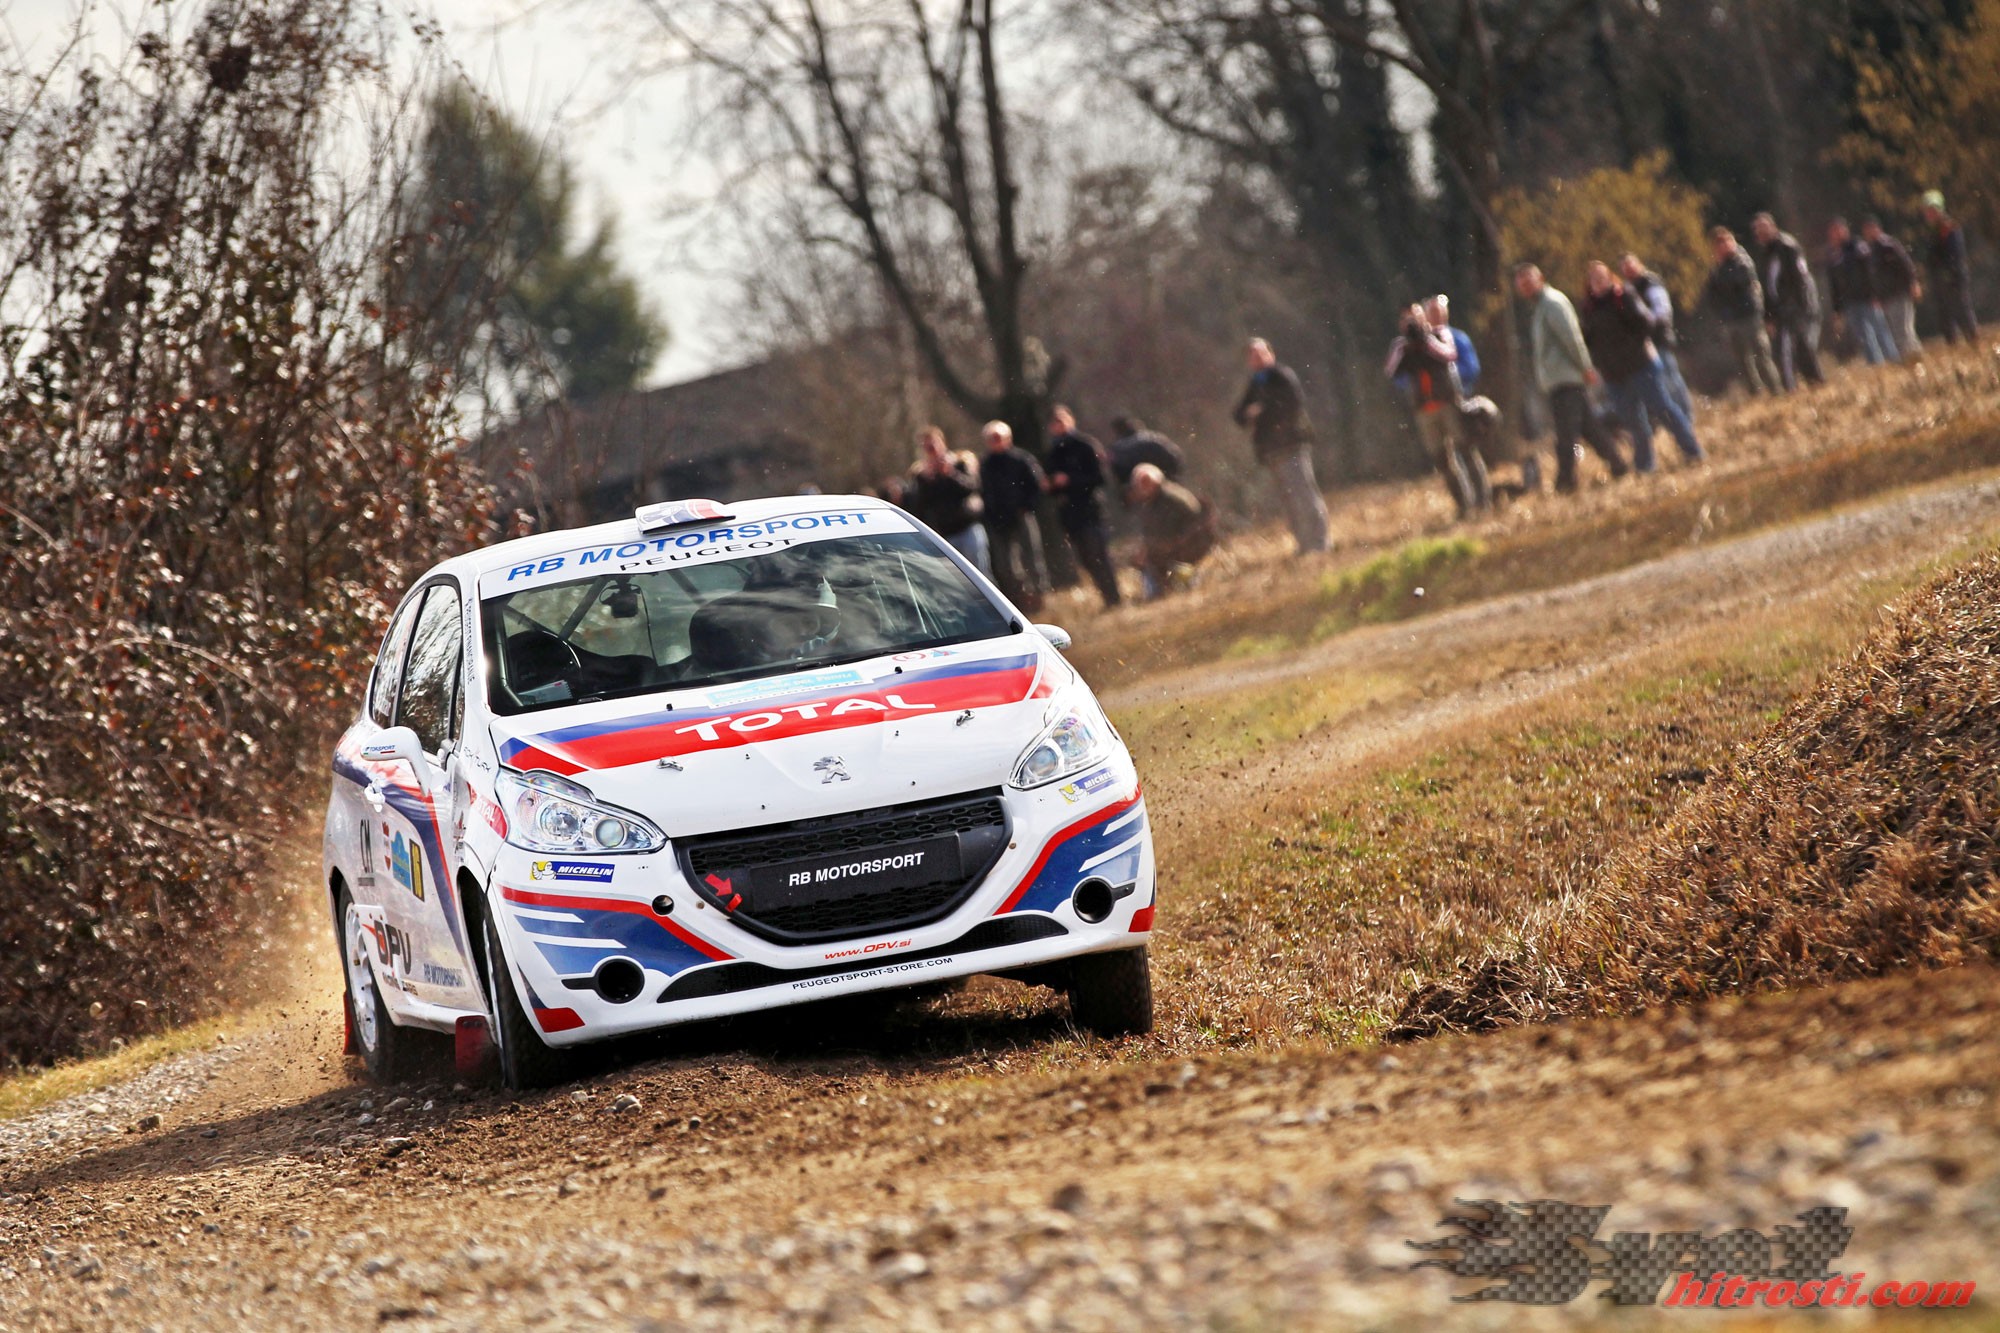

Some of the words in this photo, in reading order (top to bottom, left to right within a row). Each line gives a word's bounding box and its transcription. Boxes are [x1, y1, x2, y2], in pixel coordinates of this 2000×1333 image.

[508, 557, 565, 581] RB
[579, 513, 871, 566] MOTORSPORT
[619, 538, 796, 571] PEUGEOT
[675, 695, 937, 742] TOTAL
[558, 866, 614, 876] MICHELIN
[789, 871, 811, 886] RB
[815, 852, 924, 882] MOTORSPORT
[824, 938, 912, 960] www.OPV.si
[792, 957, 953, 990] PEUGEOTSPORT-STORE.COM
